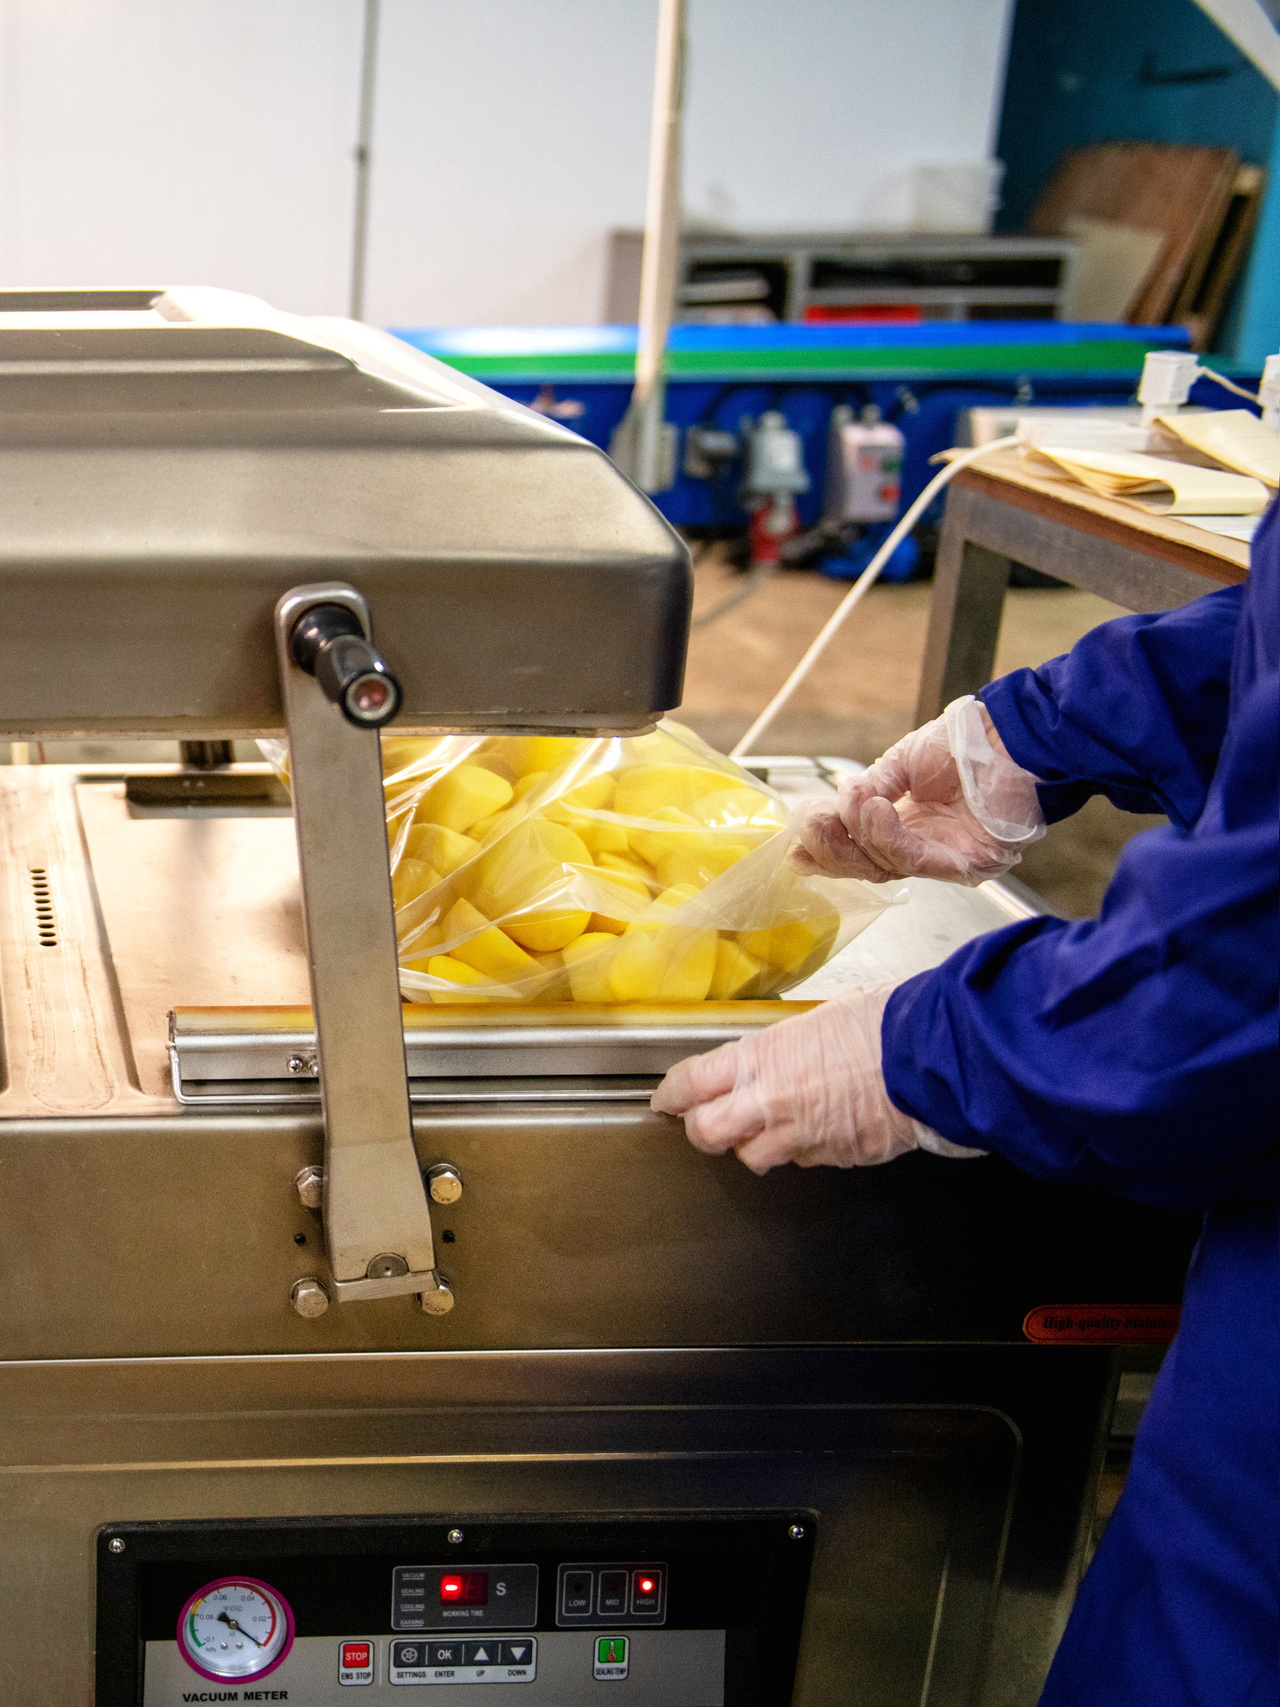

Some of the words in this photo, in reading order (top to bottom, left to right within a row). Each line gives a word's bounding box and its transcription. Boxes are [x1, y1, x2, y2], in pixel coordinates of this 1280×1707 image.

[1043, 1316, 1122, 1332] High-quality
[1123, 1315, 1177, 1330] Stainles
[495, 1582, 507, 1596] S
[470, 1609, 484, 1617] TIME
[345, 1651, 368, 1661] STOP
[437, 1649, 452, 1661] OK
[341, 1671, 354, 1680] EMS
[355, 1671, 372, 1680] STOP
[396, 1670, 427, 1679] SETTINGS
[434, 1670, 455, 1678] ENTER
[476, 1669, 485, 1677] UP
[507, 1669, 527, 1677] DOWN
[182, 1692, 238, 1703] VACUUM
[243, 1690, 288, 1701] METER
